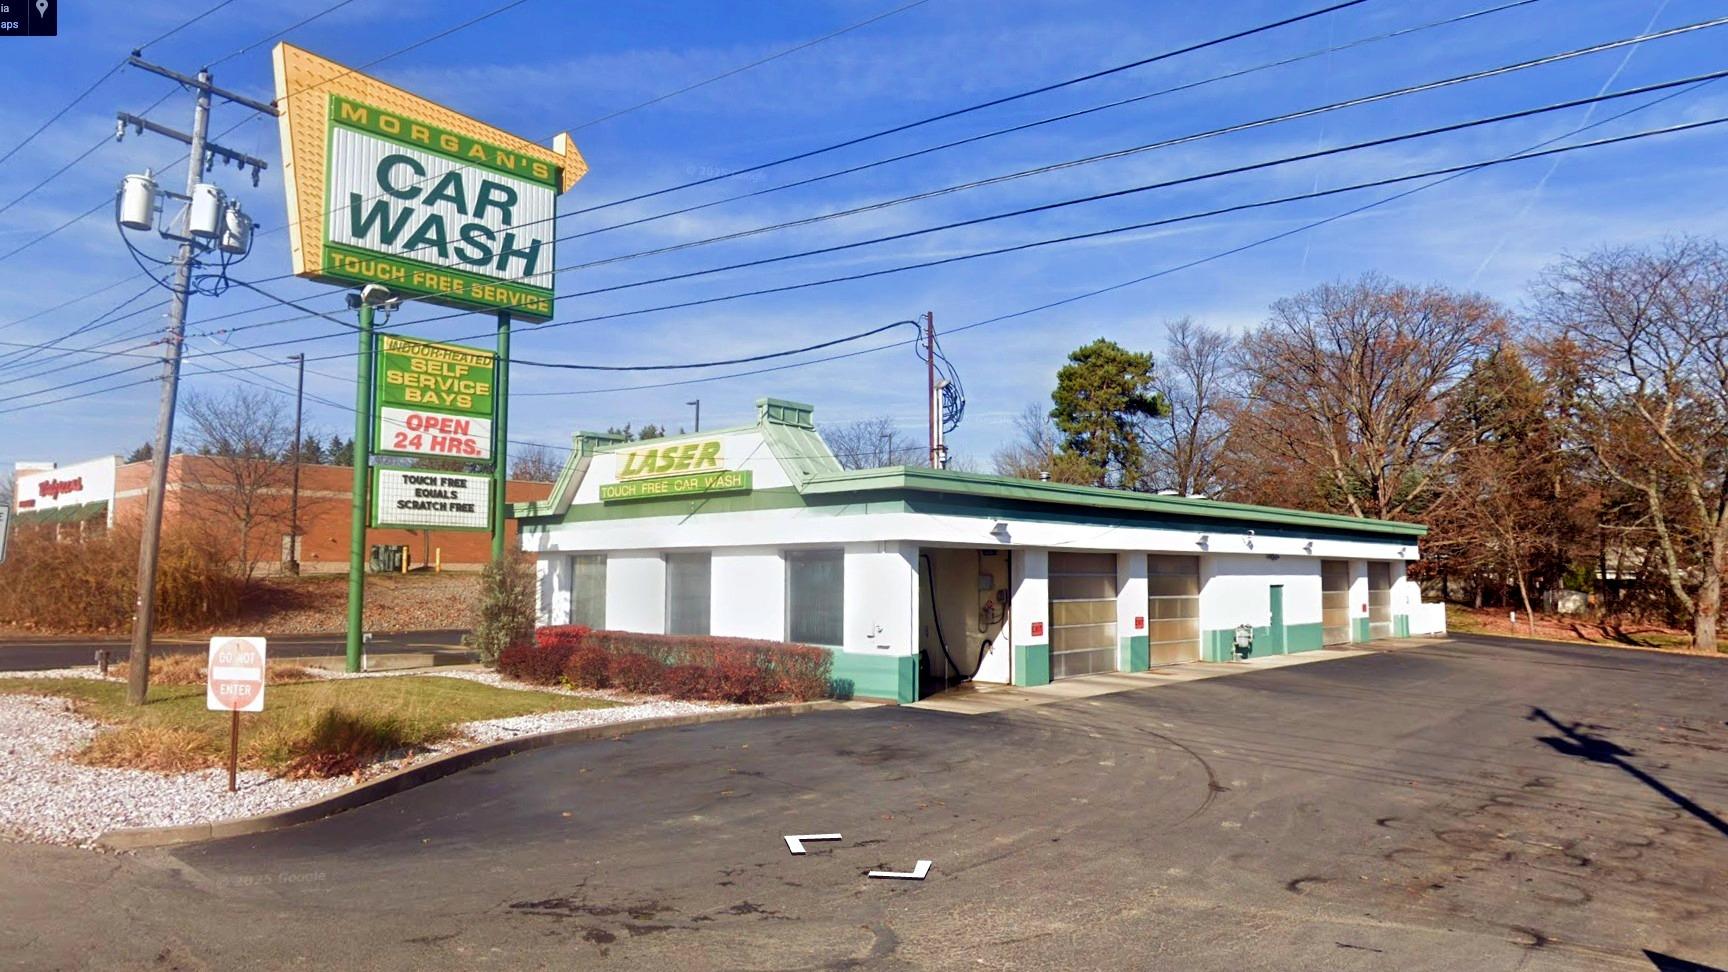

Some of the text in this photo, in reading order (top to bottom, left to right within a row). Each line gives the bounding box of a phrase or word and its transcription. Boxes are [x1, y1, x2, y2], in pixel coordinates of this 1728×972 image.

[341, 102, 549, 179] MORGAN'S
[376, 153, 518, 226] CAR
[350, 192, 541, 277] WASH
[331, 253, 549, 312] TOUCH FREE SERVICE
[411, 358, 469, 378] SELF
[386, 370, 490, 396] SERVICE
[405, 387, 472, 408] BAYS
[406, 414, 470, 436] OPEN
[394, 432, 482, 456] 24 HRS.
[621, 441, 721, 477] LASER
[402, 474, 467, 488] TOUCH FREE
[602, 475, 742, 498] TOUCH FREE CAR WASH
[415, 488, 458, 499] EQUALS
[397, 500, 475, 513] SCRATCH FREE
[218, 652, 233, 664] DO
[220, 684, 252, 697] ENTER
